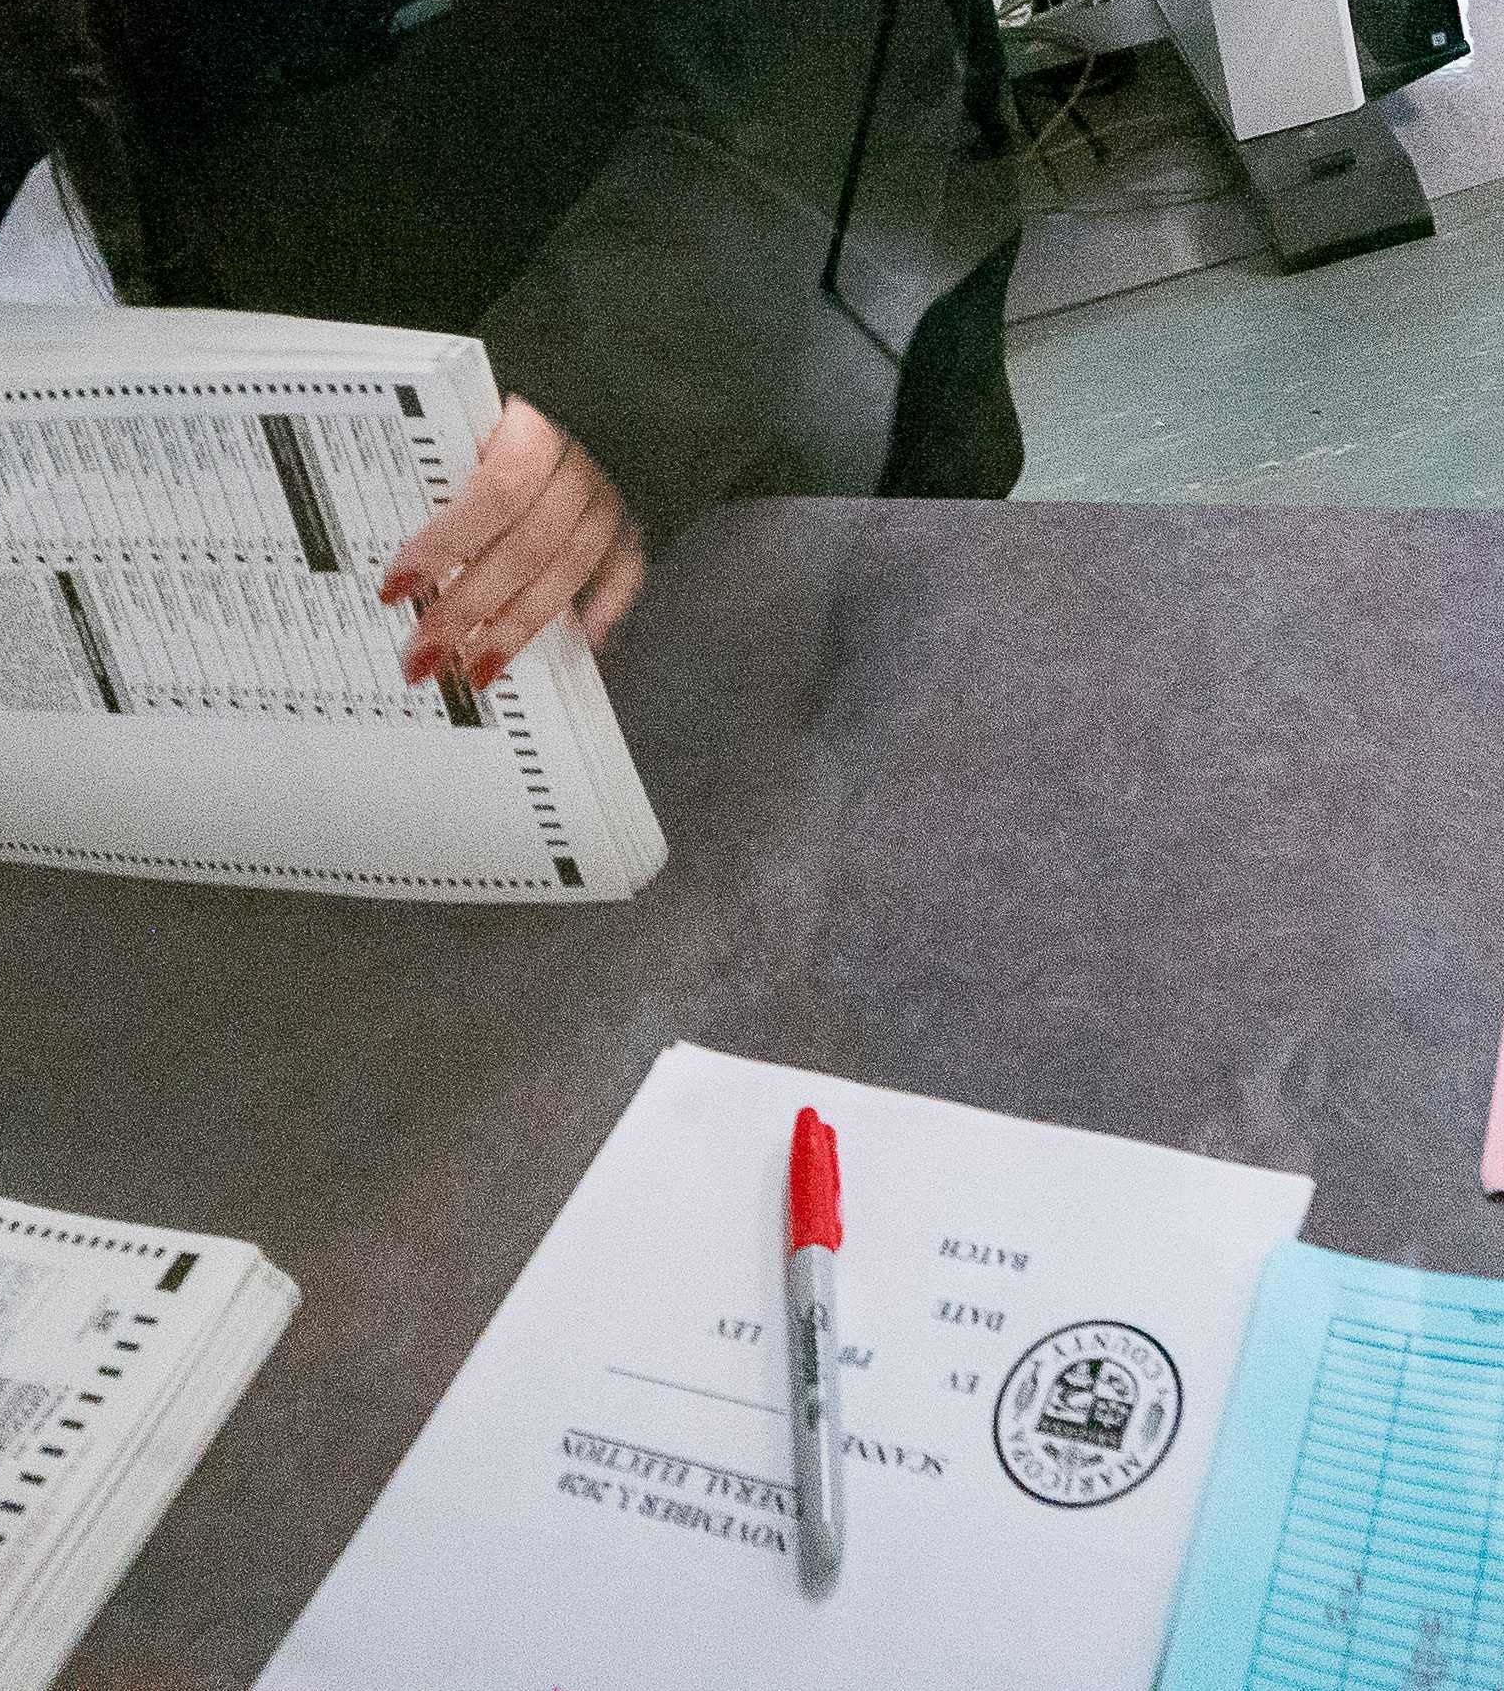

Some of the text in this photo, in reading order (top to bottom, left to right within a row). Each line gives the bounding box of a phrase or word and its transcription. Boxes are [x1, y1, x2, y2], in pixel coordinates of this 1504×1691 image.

[937, 1237, 1031, 1272] BATCH
[936, 1299, 1006, 1332] DATE
[561, 1435, 691, 1489] ELECTION
[638, 1494, 787, 1555] NOVEMBER
